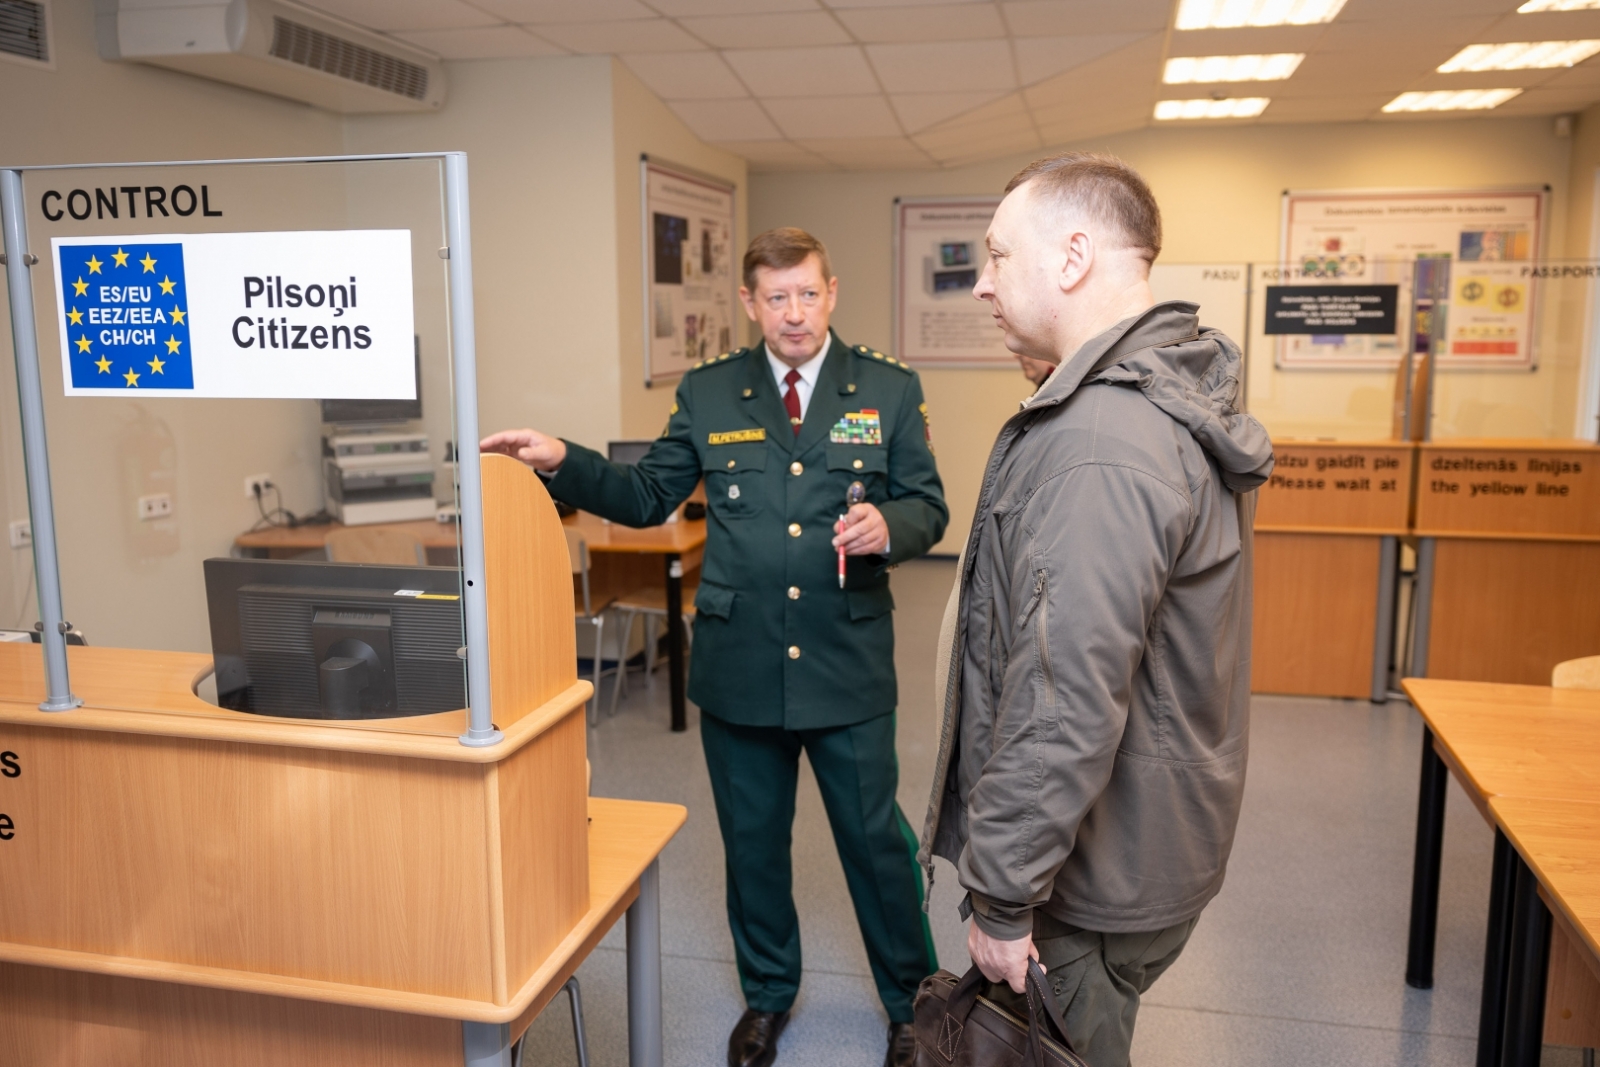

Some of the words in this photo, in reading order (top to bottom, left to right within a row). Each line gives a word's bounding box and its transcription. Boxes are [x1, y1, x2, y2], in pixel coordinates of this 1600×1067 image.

[41, 184, 223, 222] CONTROL
[99, 285, 152, 303] ES/EU
[243, 275, 357, 318] Pilsoņi
[88, 307, 167, 325] EEZ/EEA
[99, 328, 156, 346] CH/CH
[231, 315, 373, 350] Citizens
[1275, 454, 1309, 469] dzu
[1373, 456, 1400, 471] pie
[1430, 457, 1518, 472] dzeltenās
[1269, 474, 1326, 490] Please
[1334, 477, 1371, 491] wait
[1379, 478, 1397, 492] at
[1430, 480, 1460, 494] the
[1470, 480, 1528, 498] yellow
[1535, 481, 1570, 497] line
